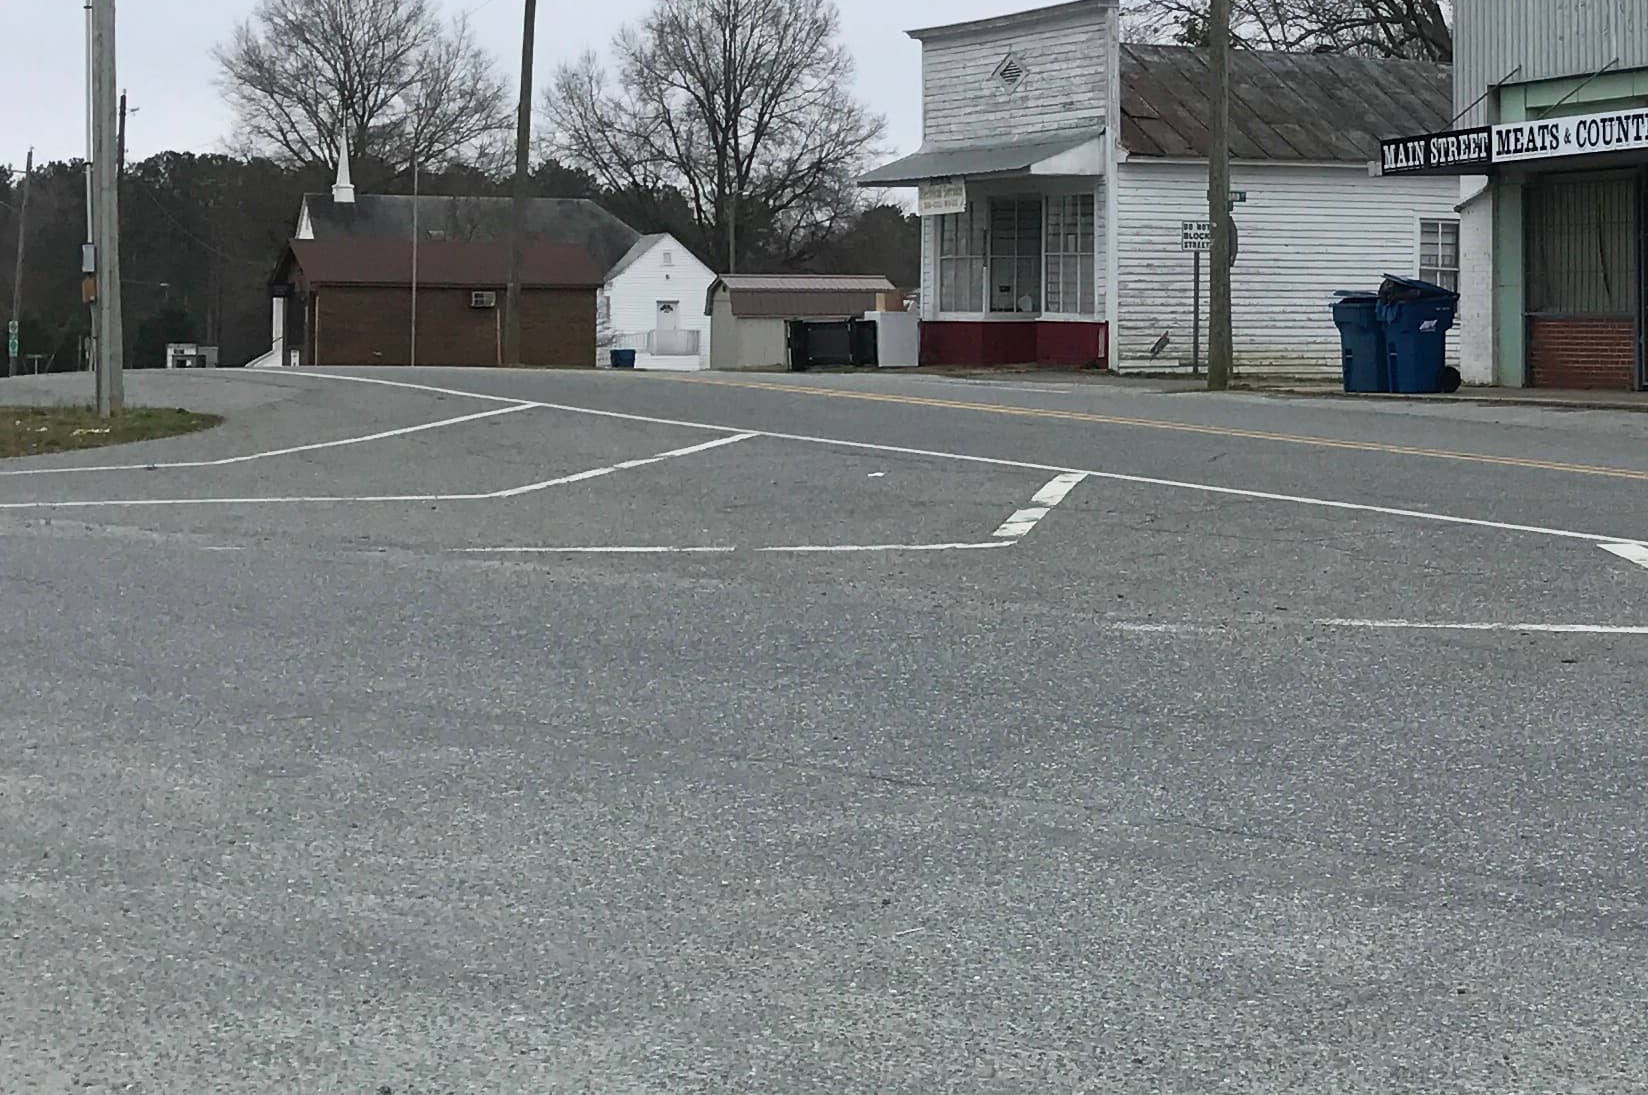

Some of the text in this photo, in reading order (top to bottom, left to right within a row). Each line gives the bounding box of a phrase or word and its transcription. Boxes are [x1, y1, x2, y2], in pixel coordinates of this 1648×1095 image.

[1383, 133, 1488, 169] MAIN STREET
[1496, 123, 1559, 155] MEATS
[1564, 128, 1571, 144] &
[1183, 232, 1211, 240] BLOCK
